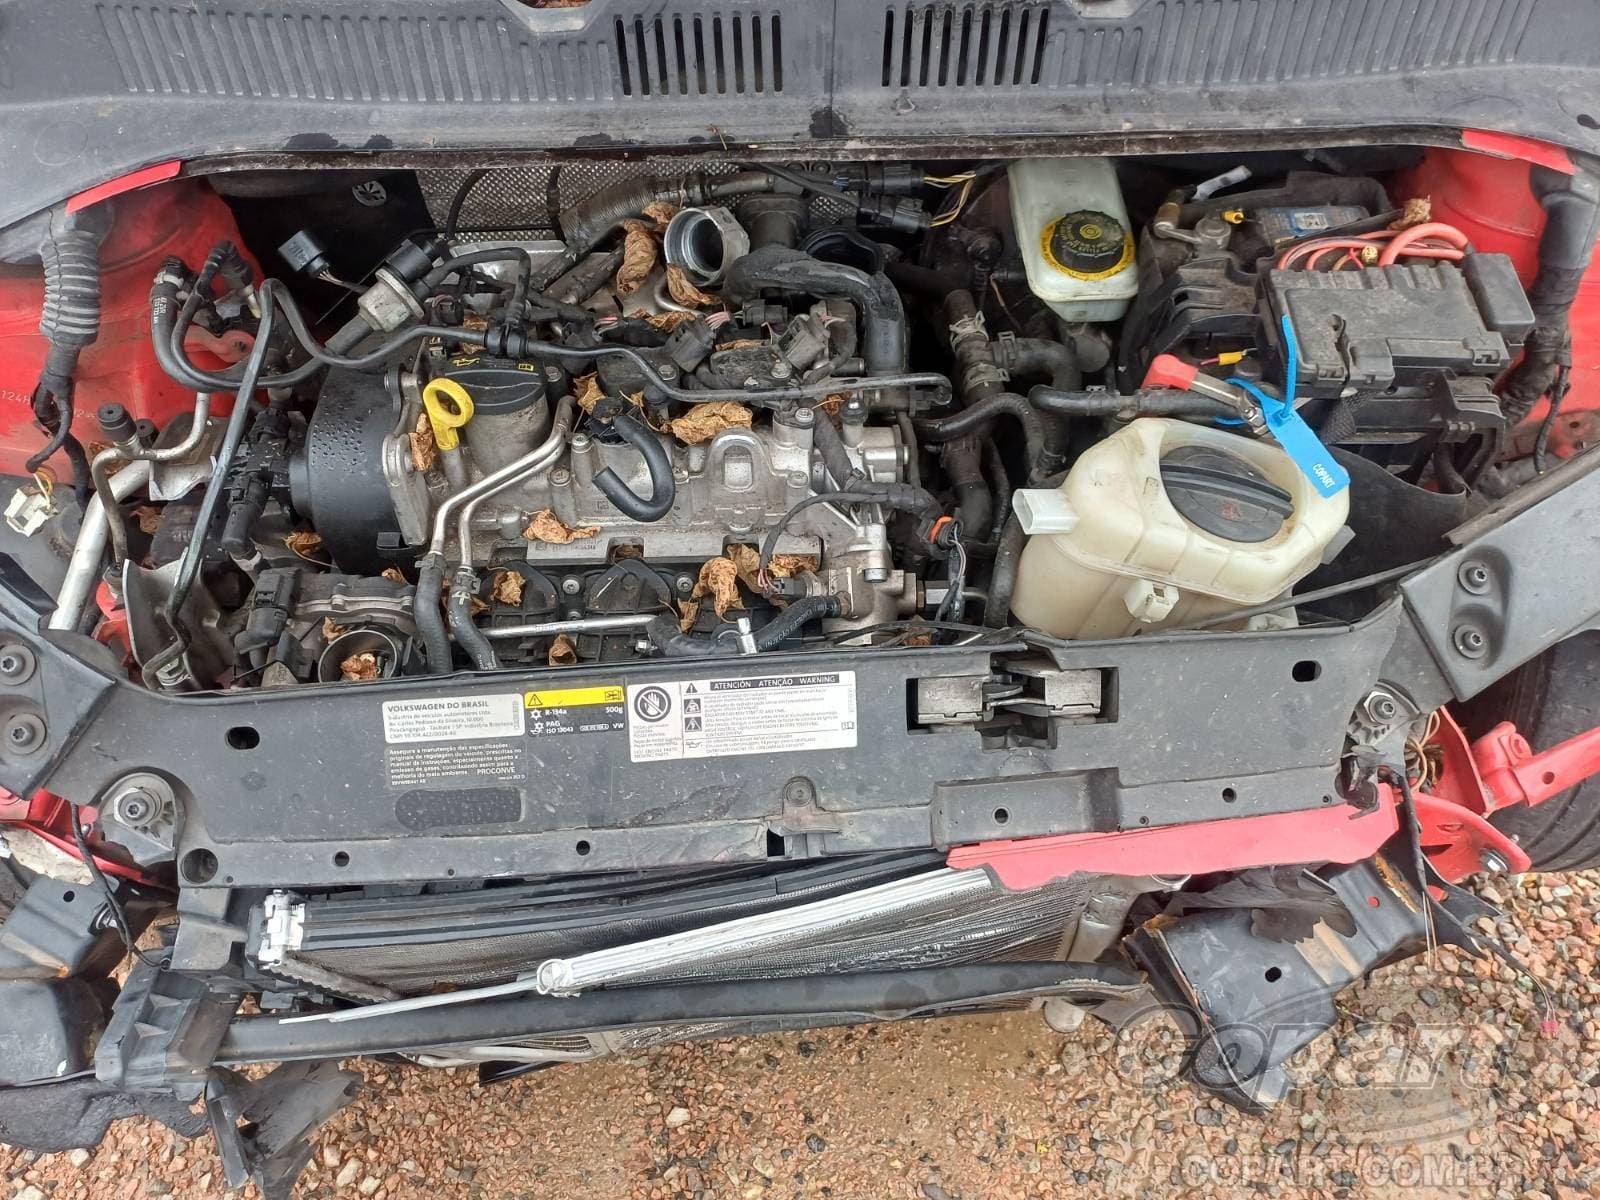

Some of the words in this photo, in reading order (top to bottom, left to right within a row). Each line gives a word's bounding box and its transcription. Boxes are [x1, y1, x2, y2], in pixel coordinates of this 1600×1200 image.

[1312, 463, 1336, 489] COPART
[713, 680, 752, 690] ATENCIÓN
[758, 677, 793, 688] ATENÇÃO
[799, 675, 836, 685] WARNING
[387, 703, 445, 713] VOLKSWAGEN
[545, 708, 568, 716] R-134a
[605, 706, 624, 714] 500g
[477, 767, 516, 776] PROCONVE
